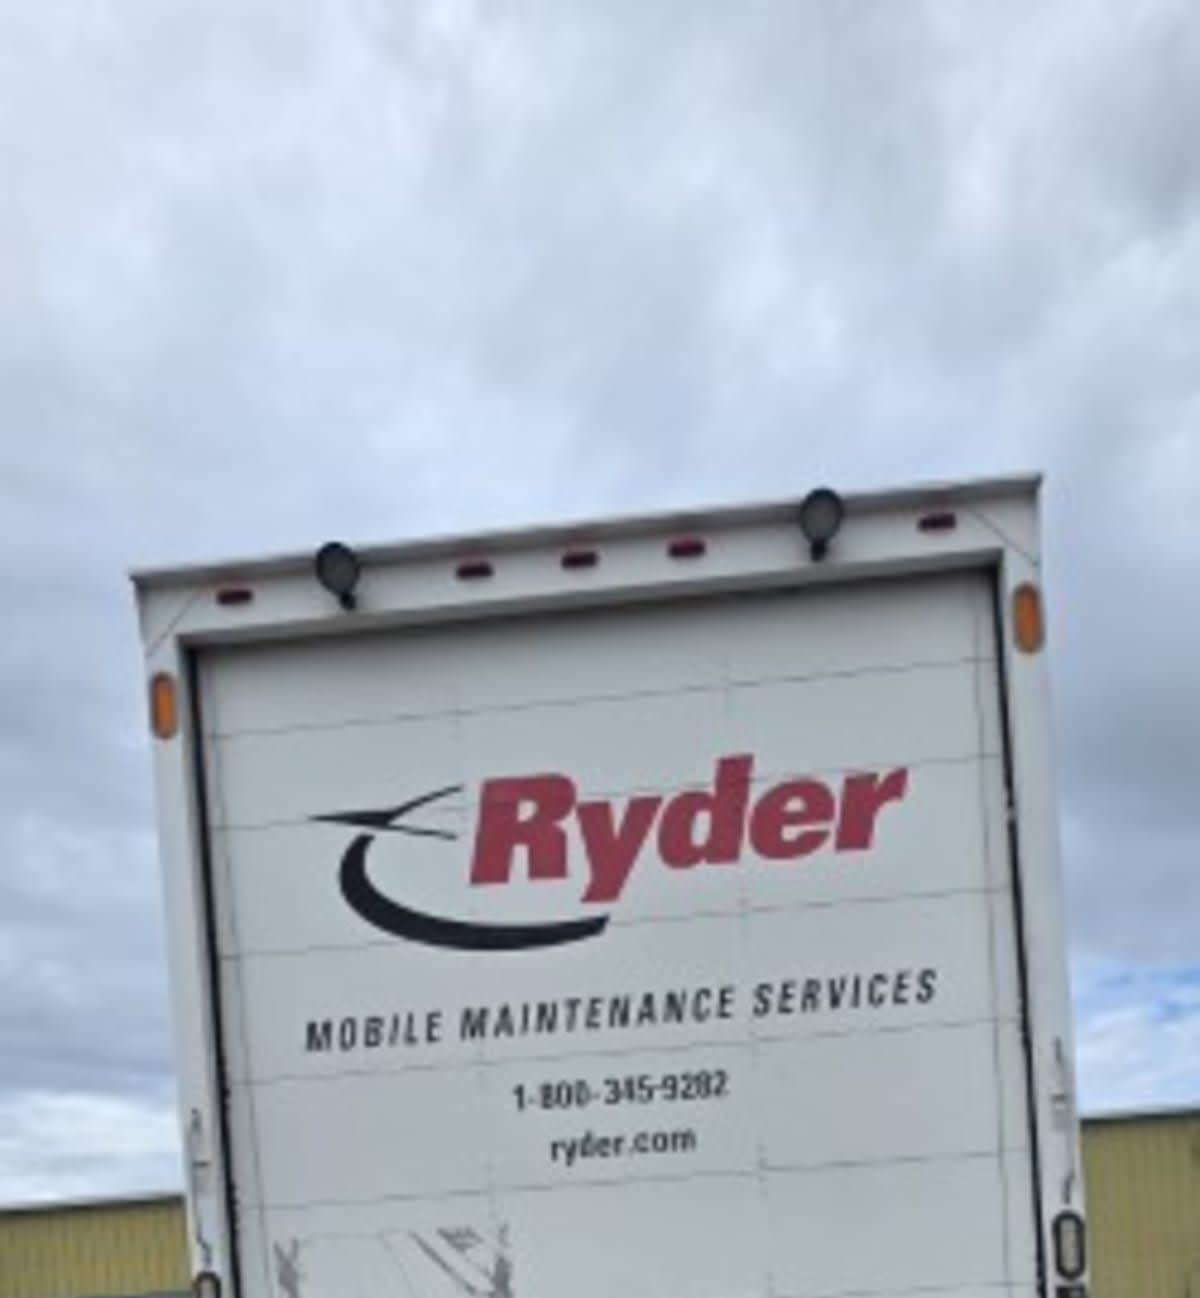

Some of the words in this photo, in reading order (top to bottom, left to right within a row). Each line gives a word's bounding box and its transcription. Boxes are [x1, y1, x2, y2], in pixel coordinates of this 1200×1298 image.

[469, 753, 909, 904] Ryder
[306, 1010, 444, 1052] MOBILE
[459, 984, 736, 1041] MAINTENANCE
[752, 968, 938, 1018] SERVICES
[512, 1069, 730, 1111] 1-800-345-9282
[551, 1128, 697, 1168] ryder.com
